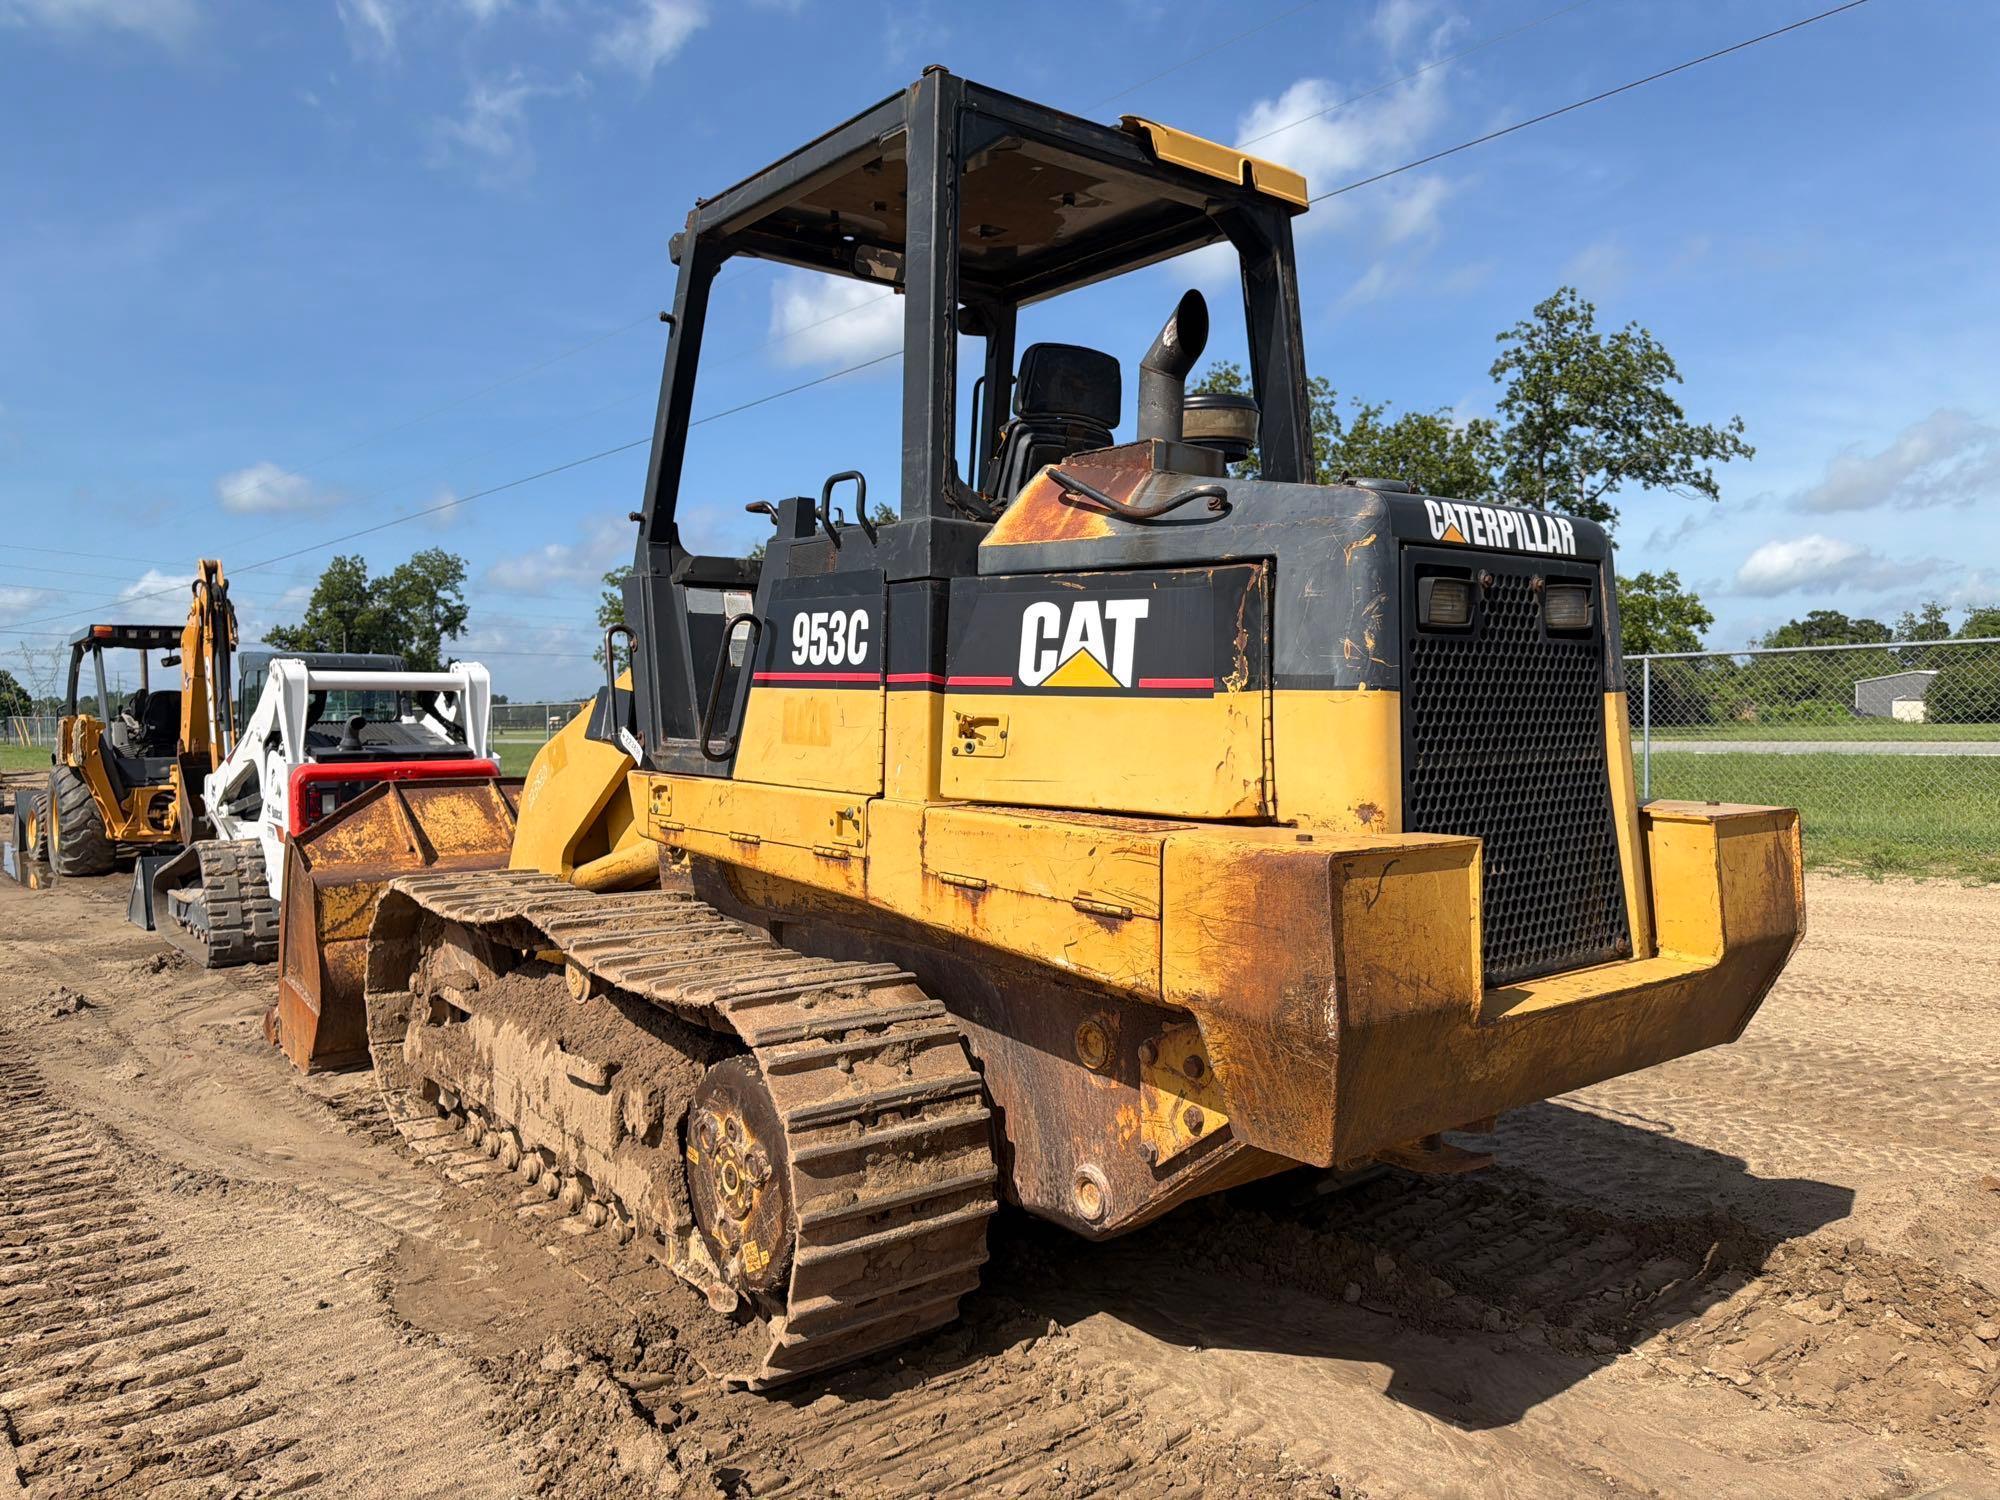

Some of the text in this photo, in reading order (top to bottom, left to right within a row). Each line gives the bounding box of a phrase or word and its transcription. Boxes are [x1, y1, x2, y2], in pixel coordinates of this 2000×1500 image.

[1423, 499, 1577, 556] CATERPILLAR
[791, 608, 869, 666] 953C
[1018, 598, 1150, 688] CAT
